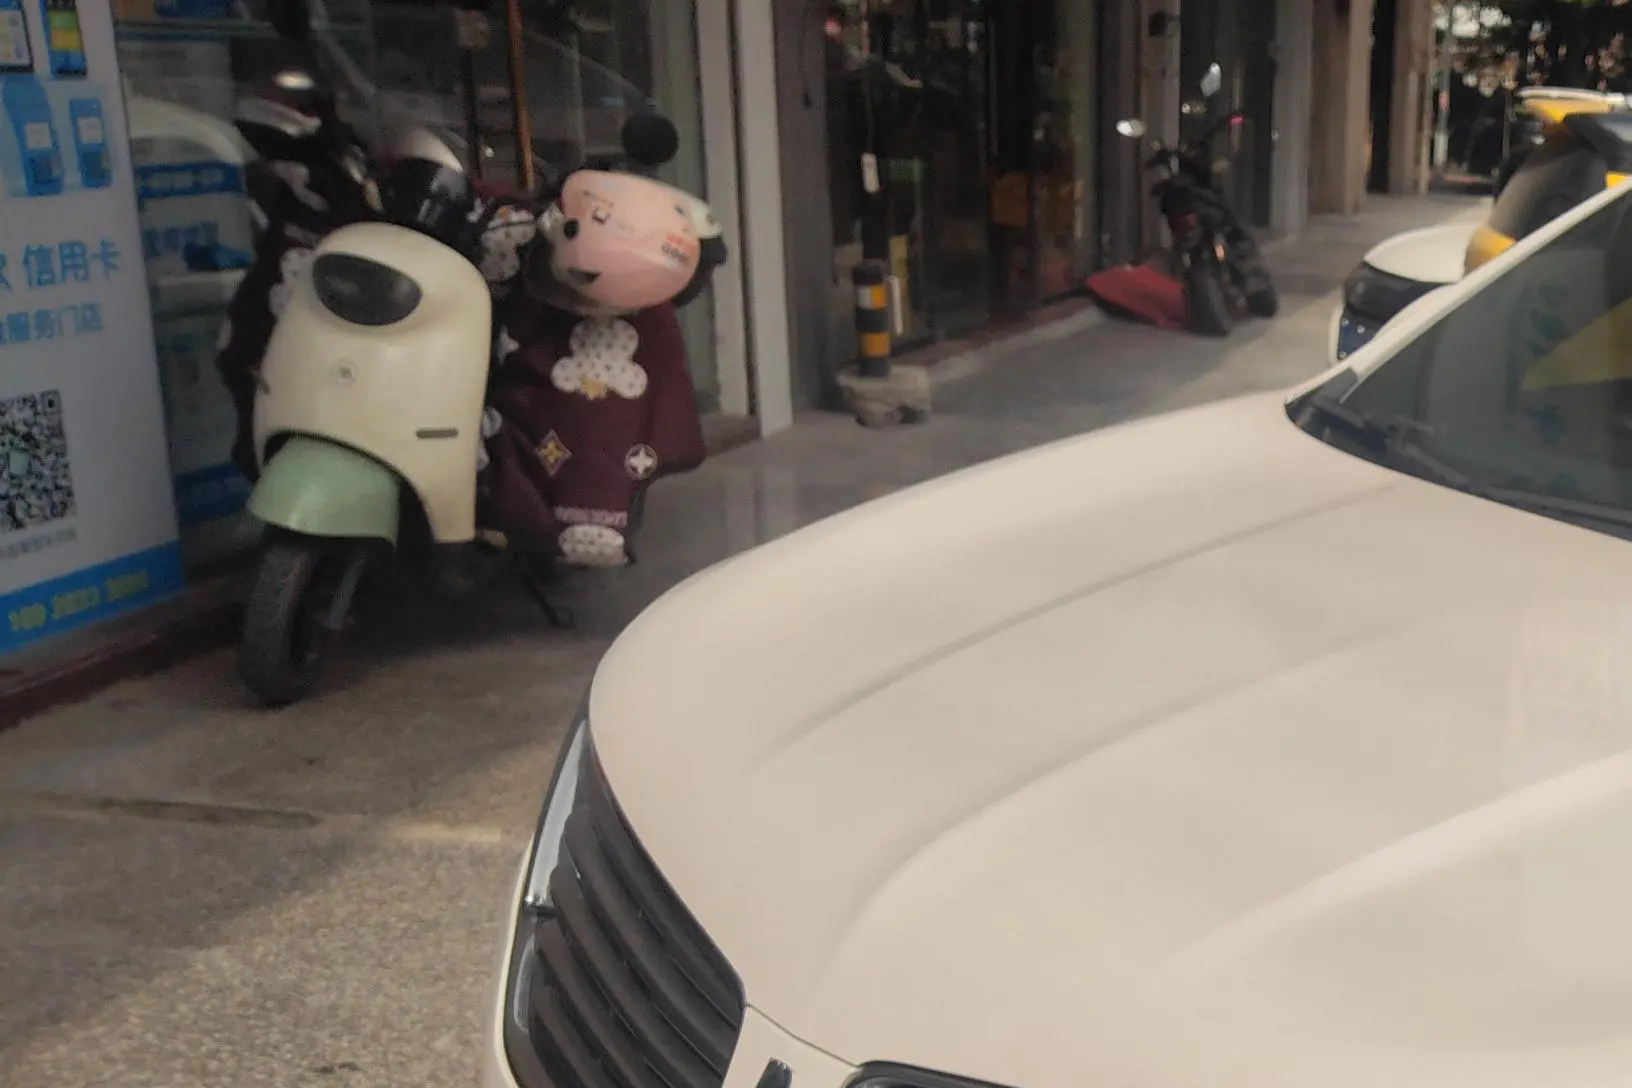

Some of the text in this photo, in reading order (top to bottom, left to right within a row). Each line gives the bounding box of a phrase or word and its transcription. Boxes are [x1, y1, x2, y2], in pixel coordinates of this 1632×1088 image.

[22, 239, 121, 288] 信用卡
[0, 302, 103, 346] 服务门店
